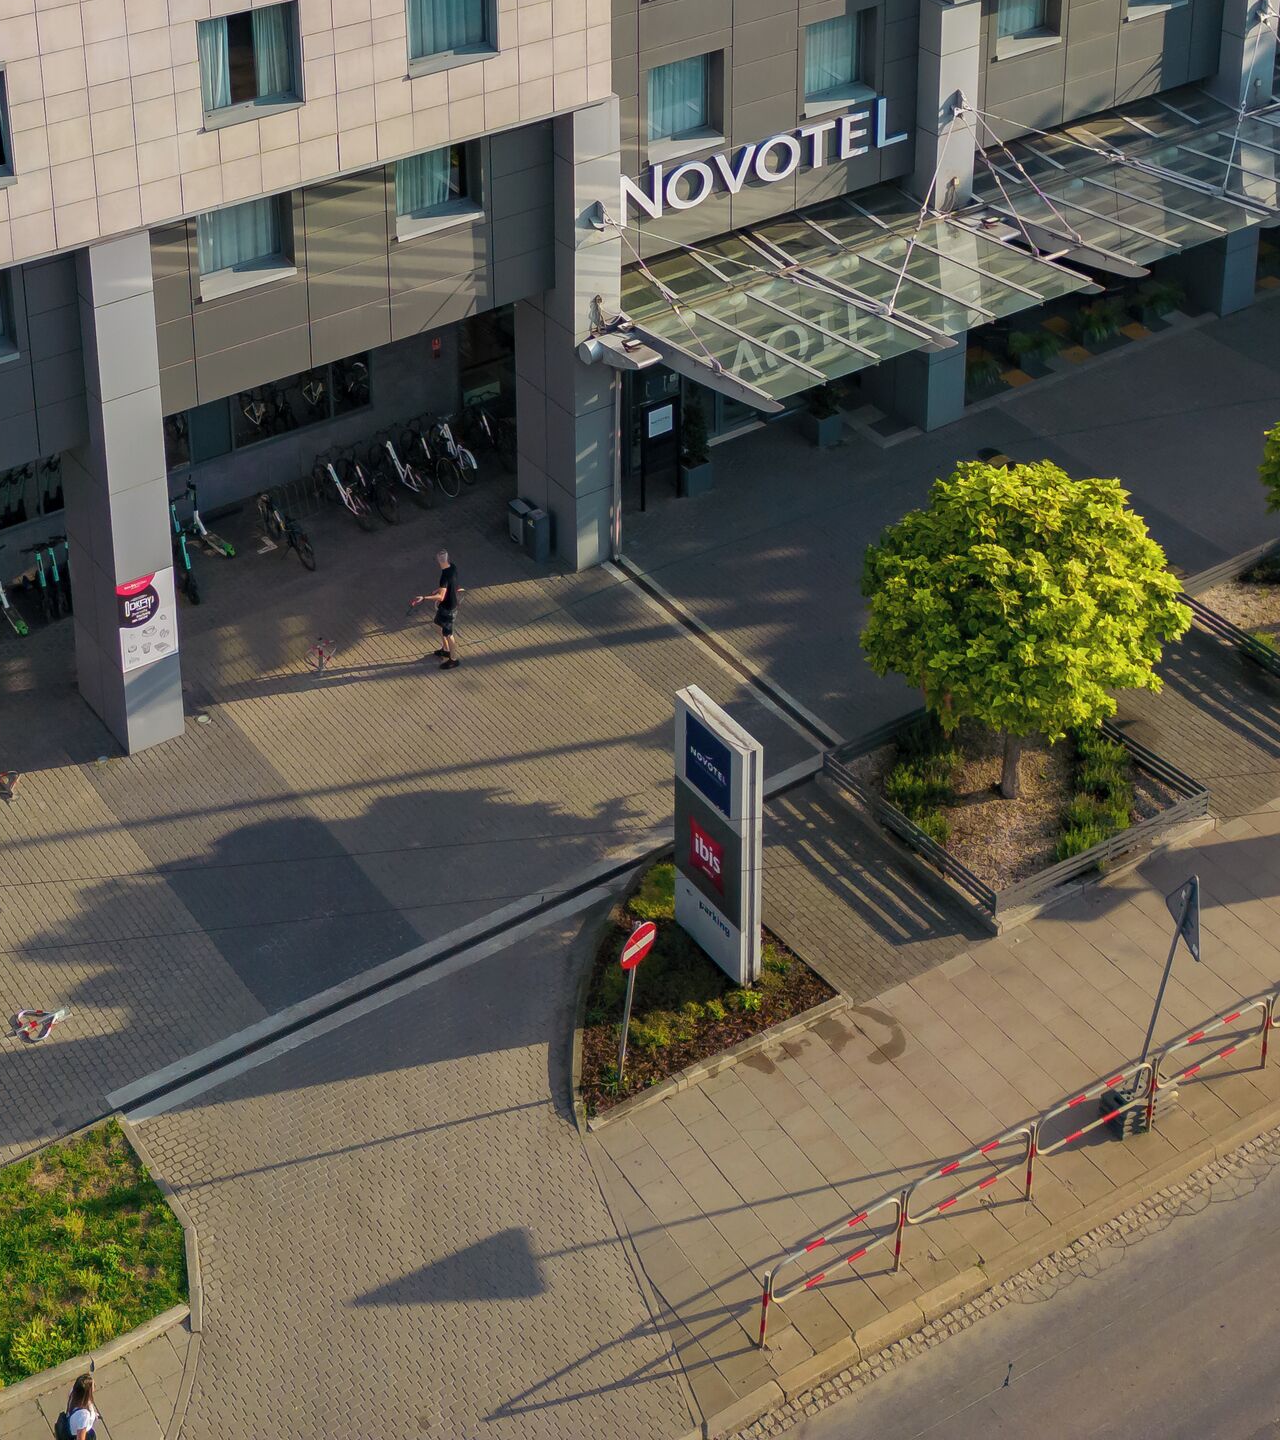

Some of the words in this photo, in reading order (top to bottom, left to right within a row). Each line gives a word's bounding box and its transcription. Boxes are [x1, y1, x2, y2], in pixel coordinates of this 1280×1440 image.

[620, 97, 908, 230] NOVOTEL
[690, 746, 727, 785] NOVOTEL
[694, 833, 721, 874] ibis
[698, 899, 731, 938] parking
